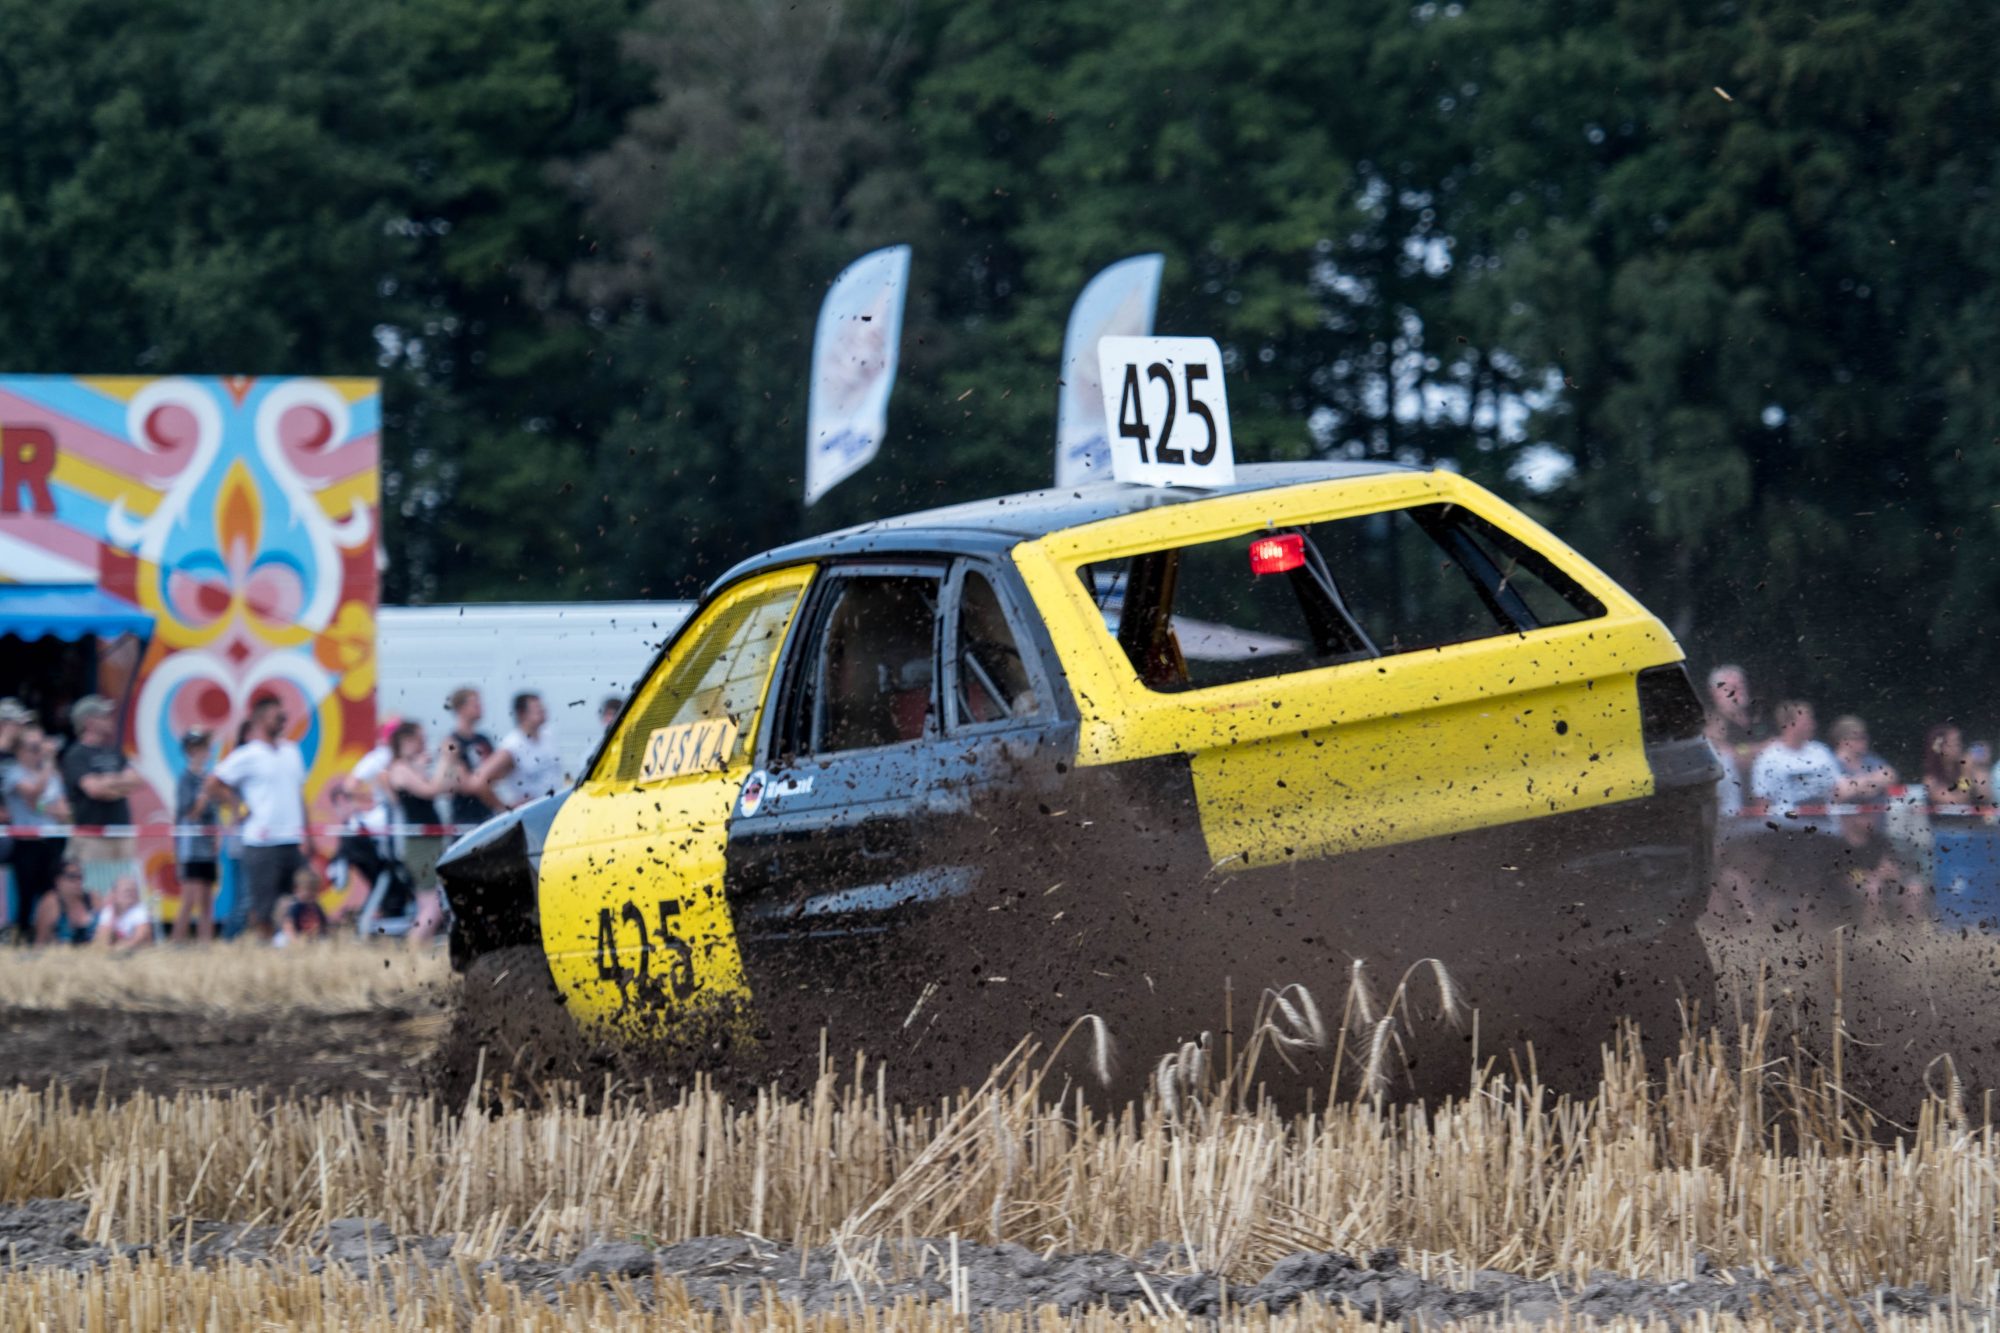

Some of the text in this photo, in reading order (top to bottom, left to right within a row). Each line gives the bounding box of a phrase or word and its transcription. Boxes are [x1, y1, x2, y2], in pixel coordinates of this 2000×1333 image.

[1119, 362, 1217, 466] 425
[645, 724, 727, 776] SISKA
[597, 899, 695, 1009] 425
